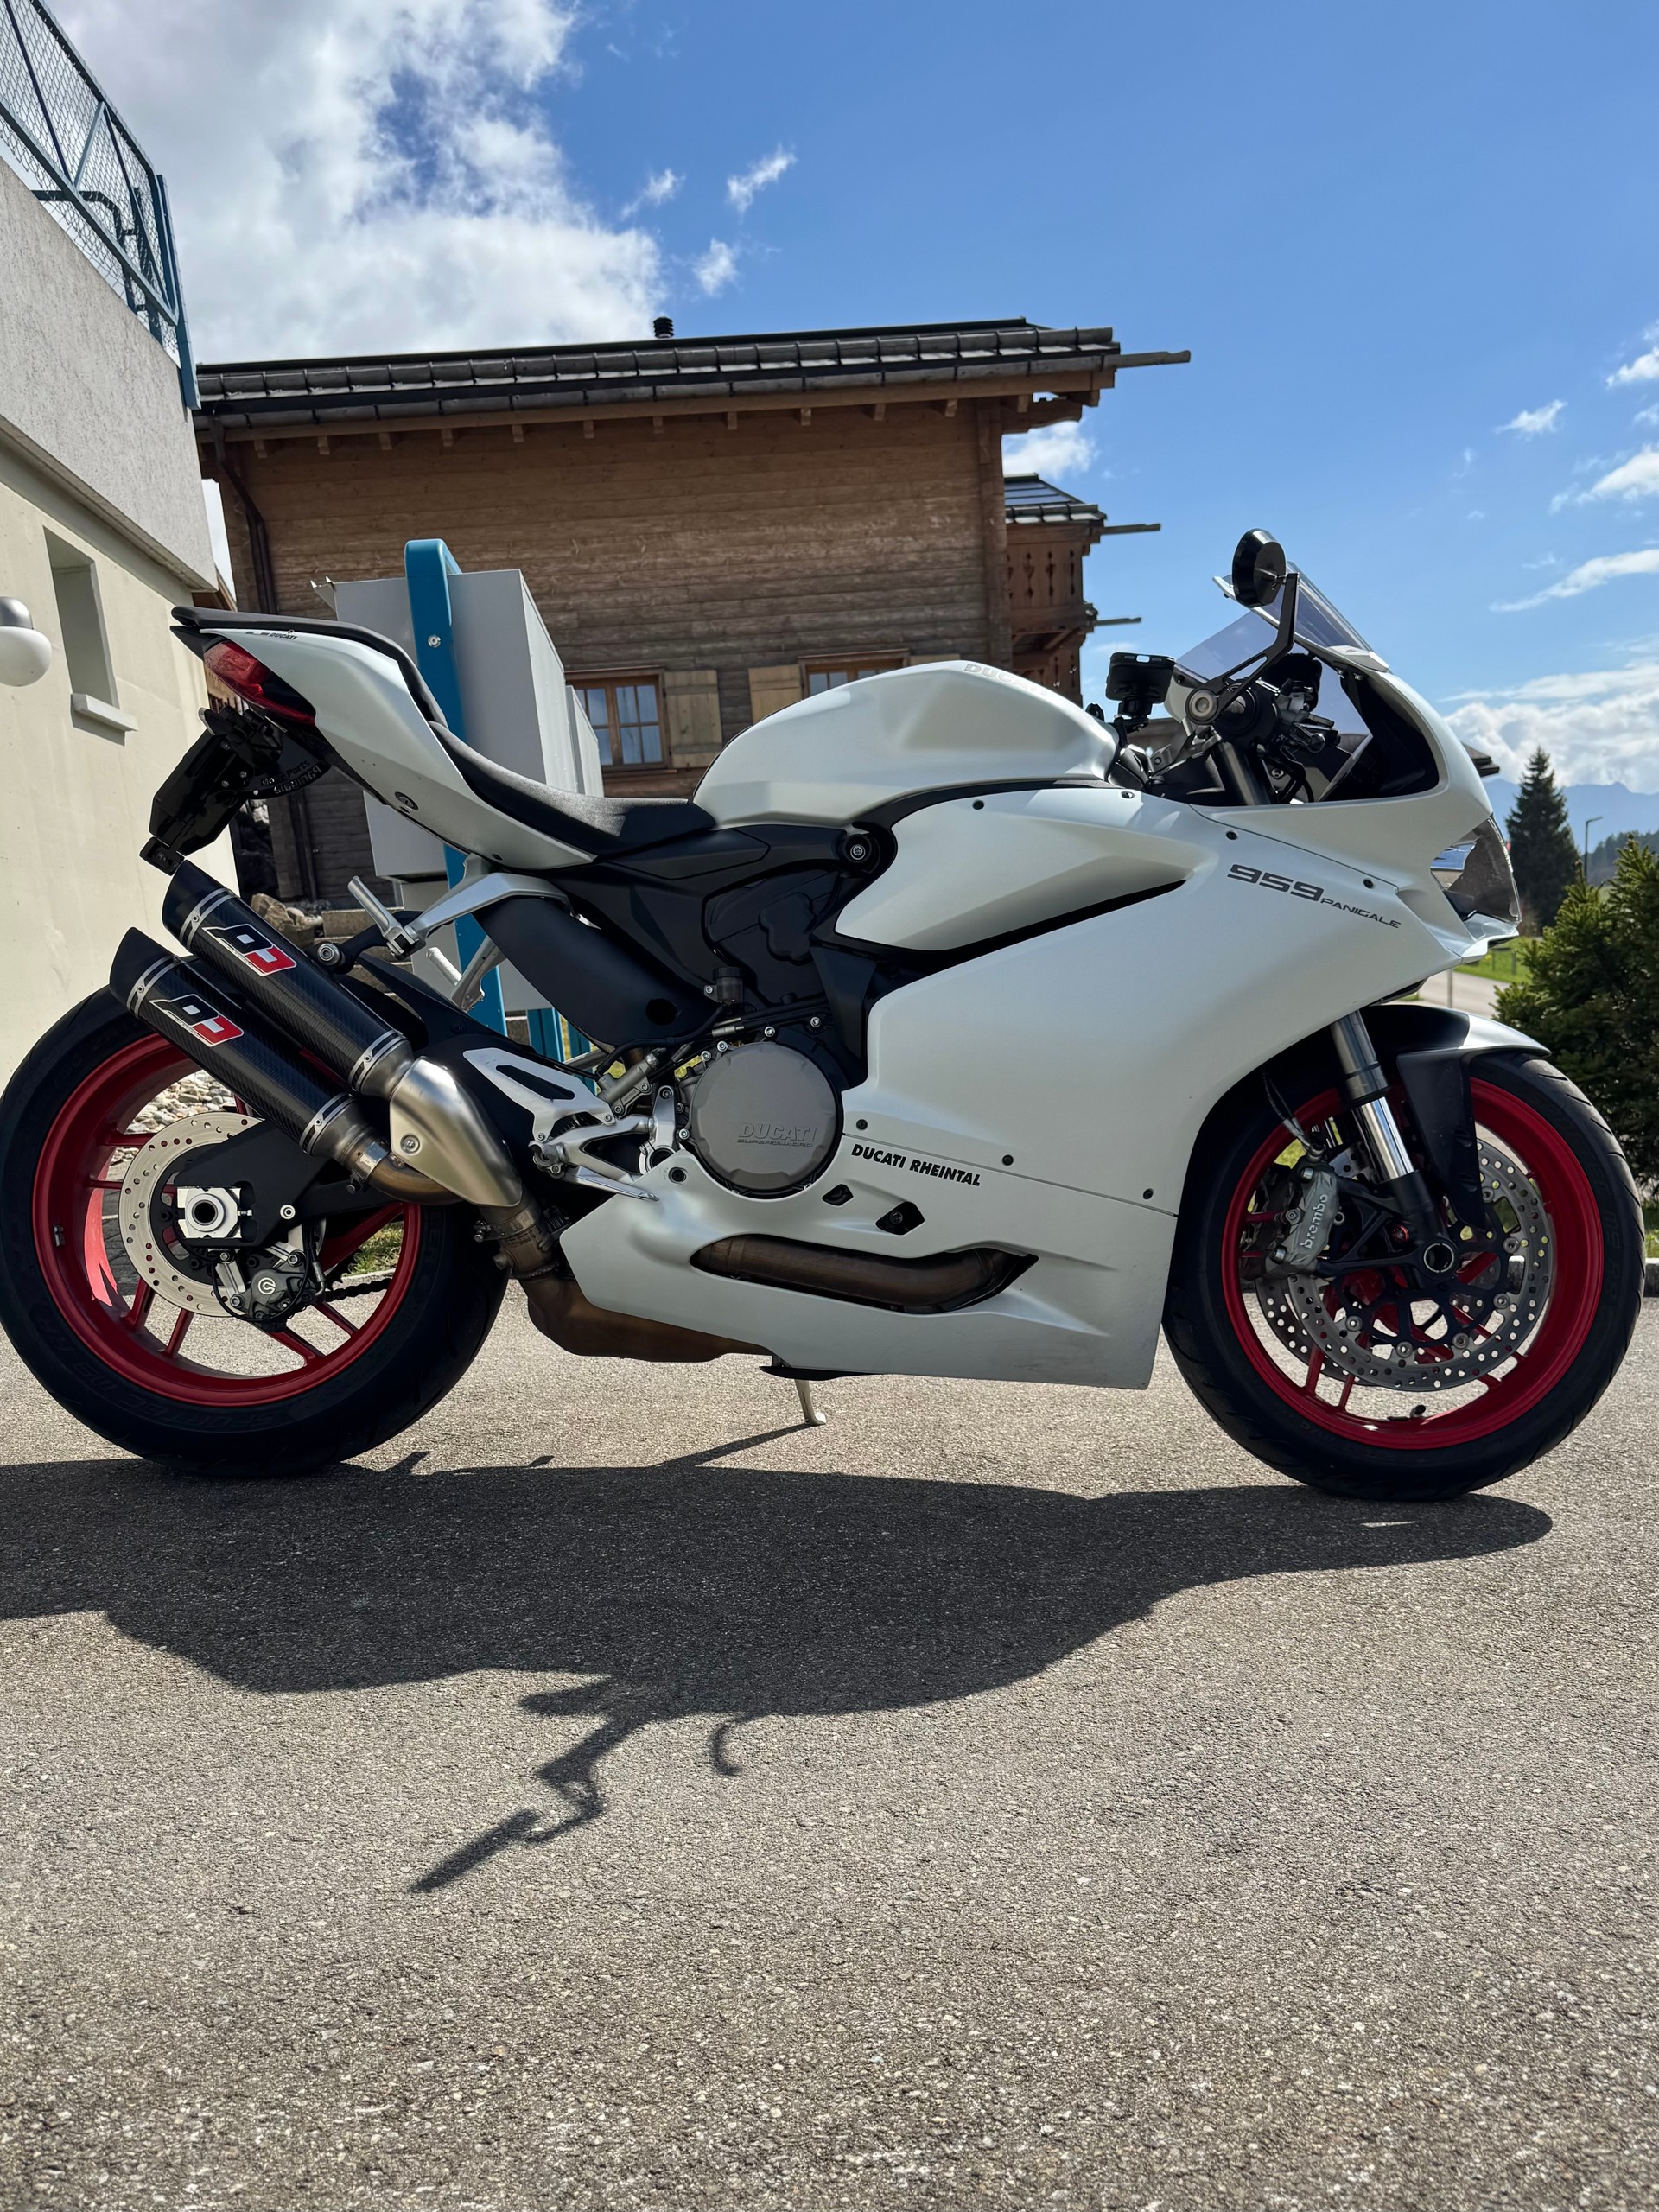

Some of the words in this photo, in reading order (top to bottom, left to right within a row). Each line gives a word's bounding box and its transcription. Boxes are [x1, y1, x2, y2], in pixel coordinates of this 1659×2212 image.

[1227, 864, 1325, 902] 959
[1320, 898, 1402, 929] PANIGALE
[738, 1122, 817, 1142] DUCATI
[851, 1143, 906, 1169] DUCATI
[909, 1159, 981, 1186] RHEINTAL
[1300, 1194, 1328, 1249] brembo
